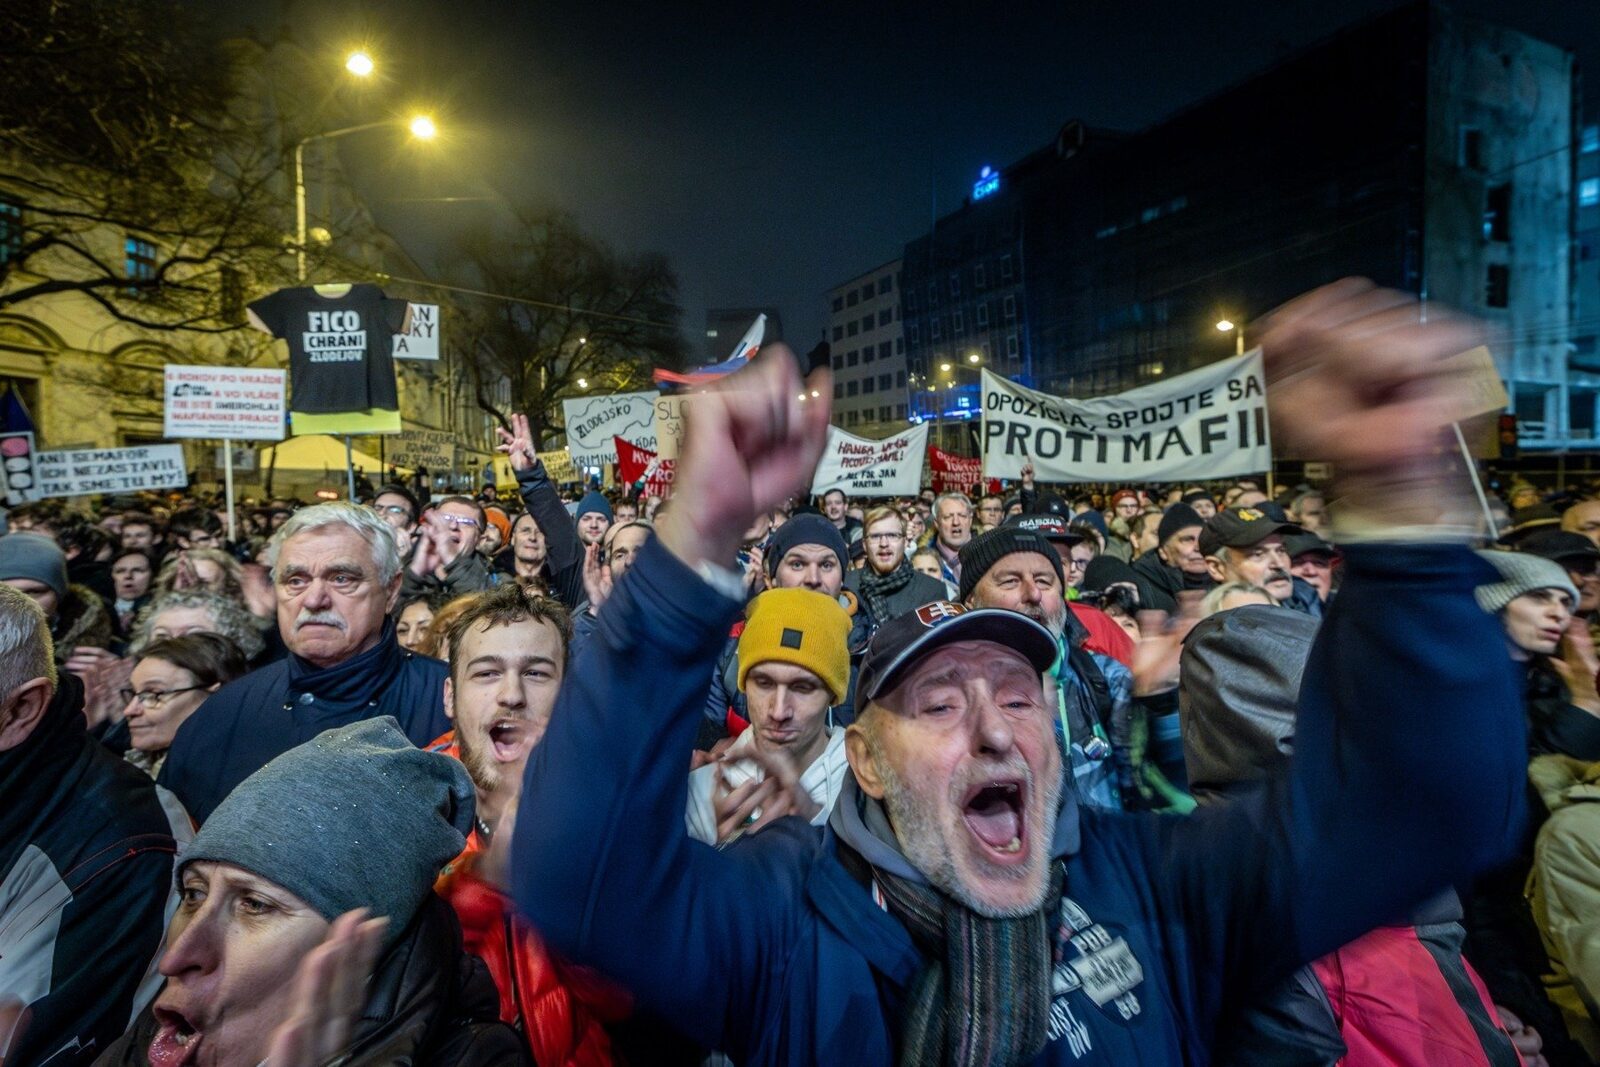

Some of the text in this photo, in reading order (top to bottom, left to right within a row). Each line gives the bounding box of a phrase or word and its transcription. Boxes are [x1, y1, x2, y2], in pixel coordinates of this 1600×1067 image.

[307, 310, 361, 332] FICO
[1107, 388, 1214, 430] SPOJTE
[1227, 375, 1263, 402] SA
[575, 404, 632, 439] ZLODEJSKO
[985, 407, 1267, 464] PROTI MAFII
[72, 449, 149, 463] SEMAFOR
[42, 470, 183, 495] TAK SME TU MY!
[879, 468, 896, 478] JAN
